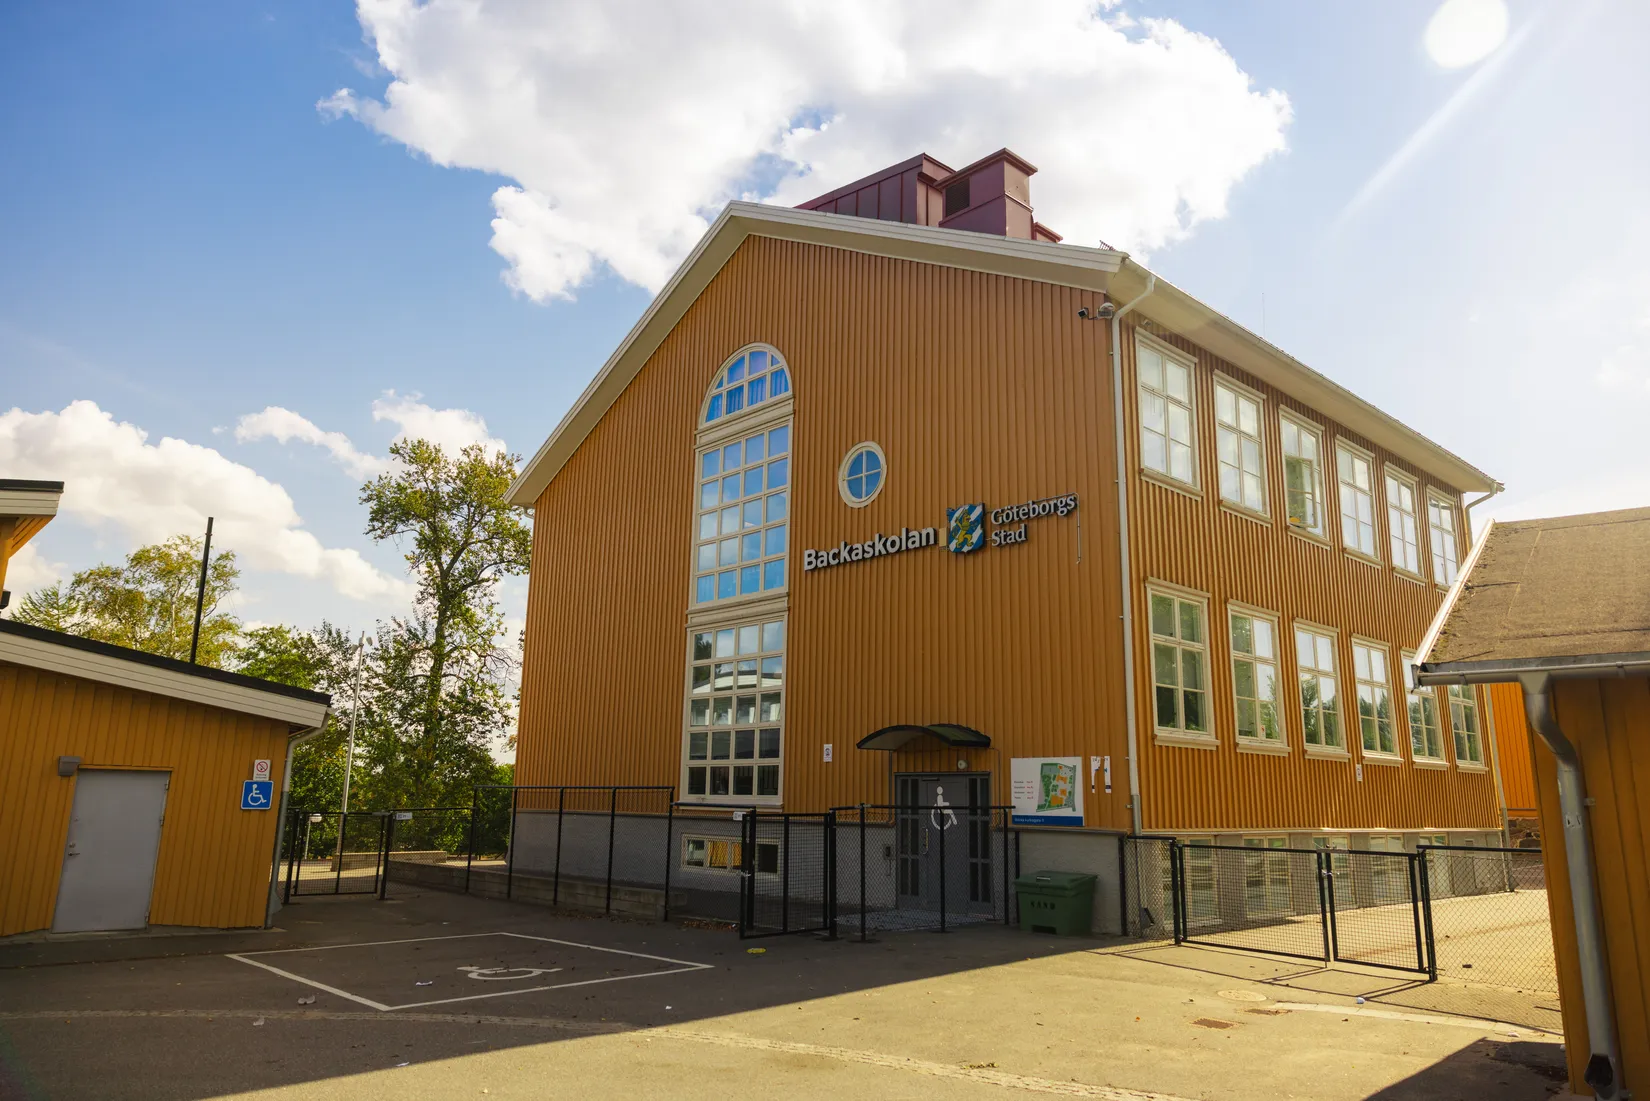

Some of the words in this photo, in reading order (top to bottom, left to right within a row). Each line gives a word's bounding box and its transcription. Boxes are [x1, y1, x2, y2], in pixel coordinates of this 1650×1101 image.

[991, 495, 1076, 525] Göteborgs
[804, 526, 936, 571] Backaskolan
[991, 523, 1028, 547] Stad
